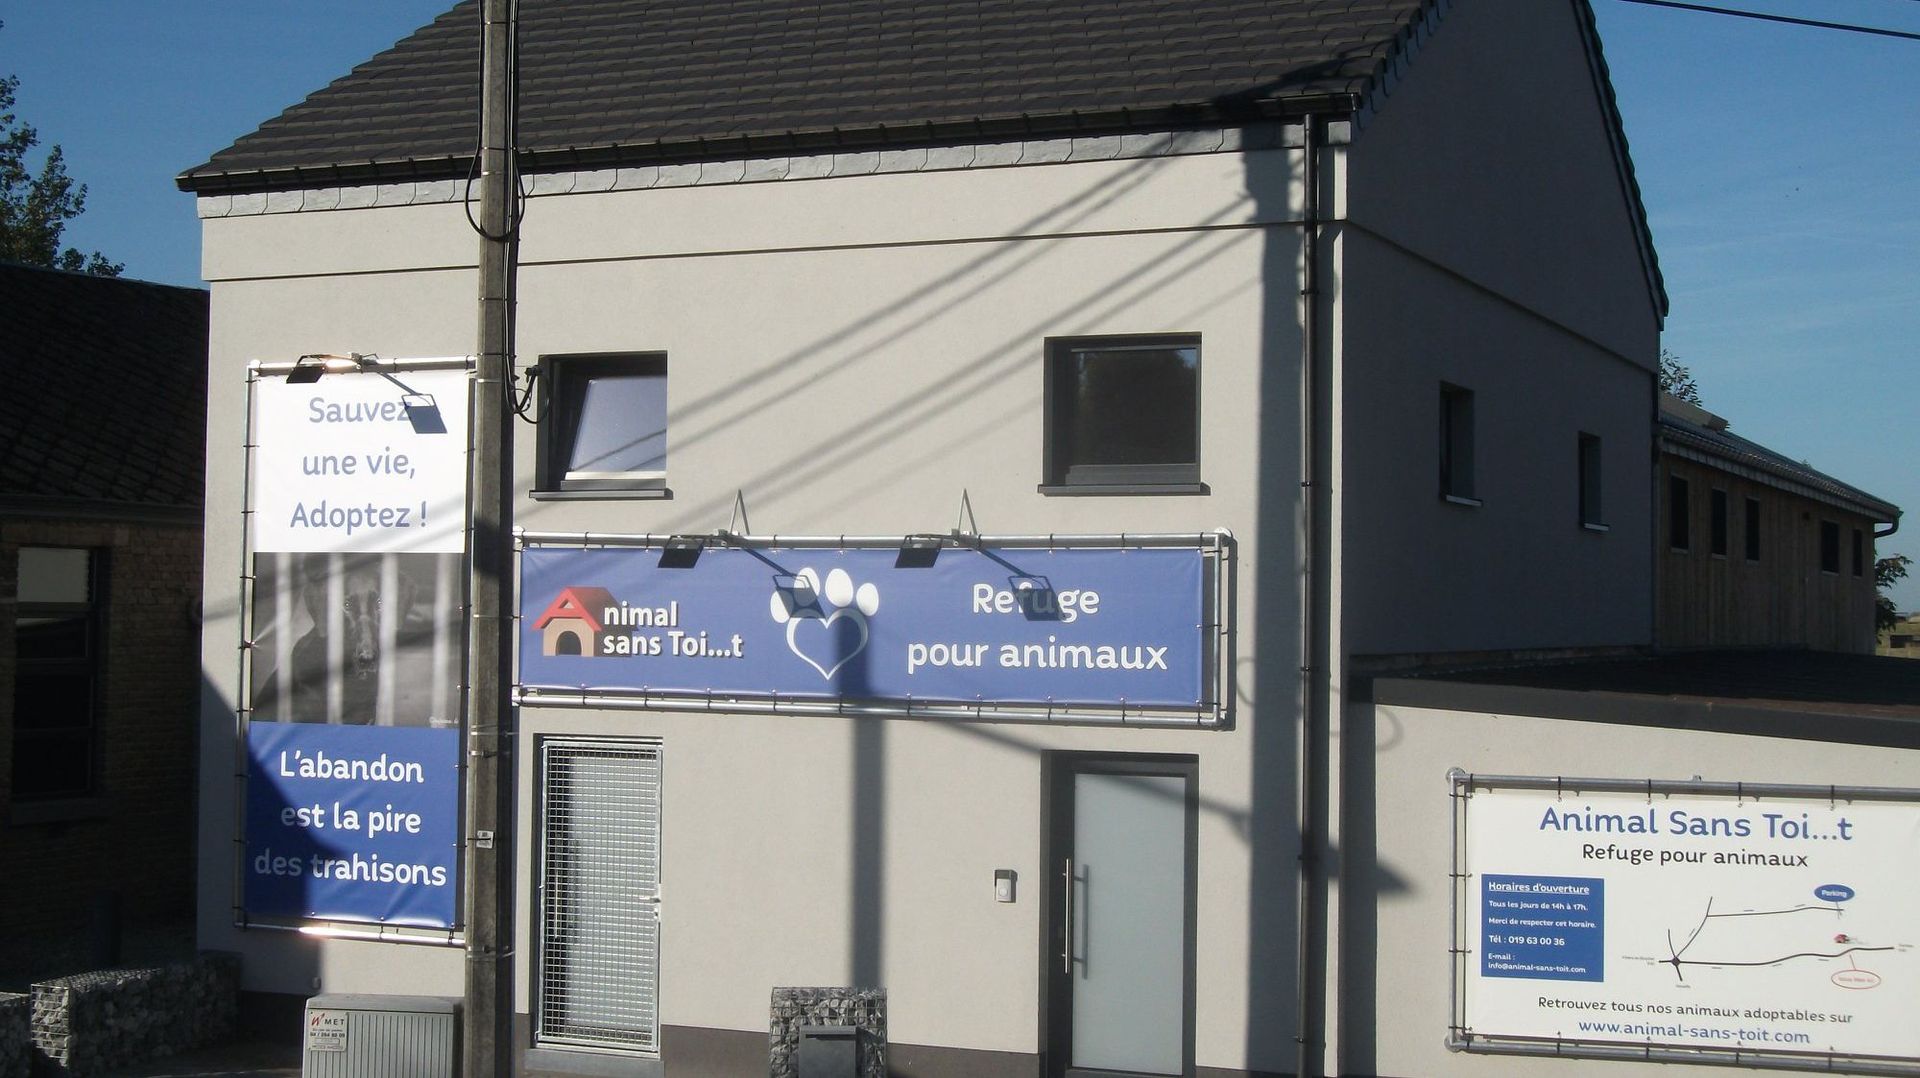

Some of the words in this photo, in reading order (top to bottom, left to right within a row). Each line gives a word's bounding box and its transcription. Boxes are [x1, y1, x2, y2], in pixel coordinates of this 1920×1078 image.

[309, 397, 413, 424] Sauvez
[303, 454, 357, 476] une
[366, 446, 415, 479] vie,
[290, 500, 411, 535] Adoptez
[972, 582, 1100, 623] Refuge
[603, 634, 661, 656] sans
[908, 642, 989, 675] pour
[999, 635, 1168, 670] animaux
[280, 751, 425, 783] L'abandon
[281, 803, 325, 829] est
[333, 801, 360, 830] la
[368, 804, 422, 838] pire
[1540, 806, 1658, 835] Animal
[1669, 810, 1751, 837] Sans
[254, 848, 302, 877] des
[311, 853, 447, 887] trahisons
[1583, 843, 1654, 866] Refuge
[1660, 847, 1707, 867] pour
[1713, 849, 1809, 868] animaux
[1488, 881, 1530, 893] Horaires
[1532, 883, 1590, 895] d'ouverture
[1488, 900, 1506, 908] Tous
[1507, 900, 1518, 908] les
[1520, 901, 1539, 910] jours
[1551, 902, 1565, 910] 14h
[1488, 917, 1508, 925] Merci
[1509, 917, 1519, 925] de
[1520, 919, 1554, 927] respecter
[1568, 920, 1597, 928] horaire.
[1488, 934, 1502, 944] Tél
[1508, 936, 1525, 944] 019
[1526, 936, 1538, 945] 63
[1539, 937, 1552, 945] 00
[1553, 938, 1565, 946] 36
[1488, 952, 1511, 960] E-mail
[1488, 962, 1587, 973] info@animal-sans-toit.com
[1538, 996, 1606, 1012] Retrouvez
[1611, 1000, 1643, 1013] tous
[1647, 1004, 1672, 1015] nos
[1676, 1003, 1740, 1019] animaux
[1743, 1006, 1826, 1024] adoptables
[1830, 1013, 1854, 1024] sur
[1578, 1019, 1811, 1044] www.animal-sans-toit.com
